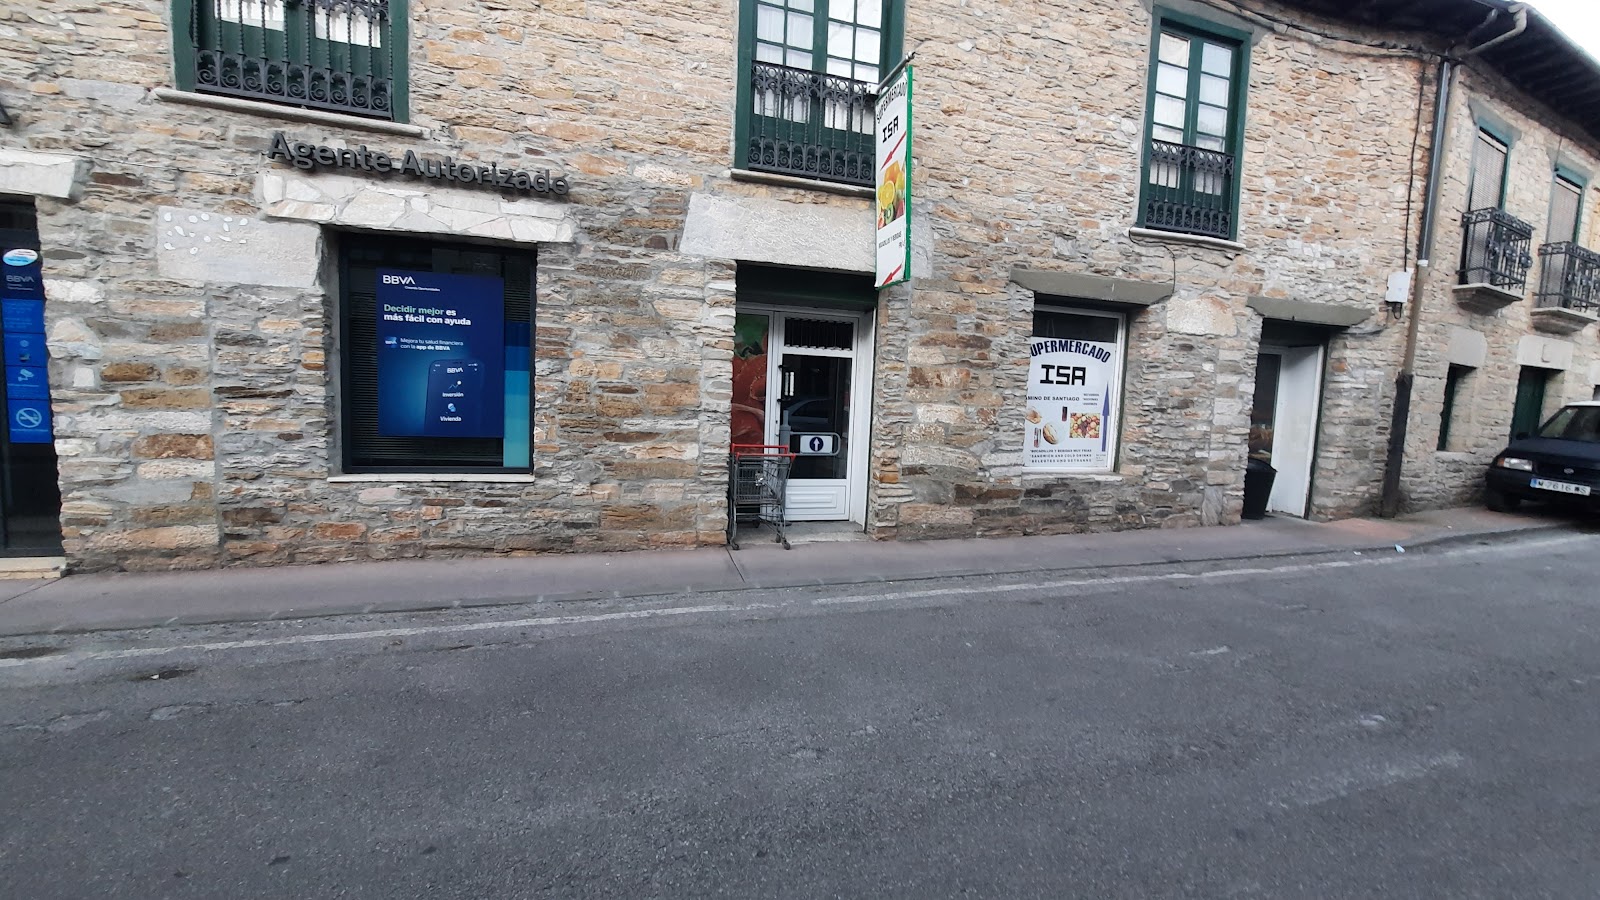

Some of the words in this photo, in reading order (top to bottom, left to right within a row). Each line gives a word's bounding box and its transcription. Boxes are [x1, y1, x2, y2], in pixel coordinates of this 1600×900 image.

[882, 115, 899, 143] ISA
[267, 133, 392, 172] Agente
[400, 149, 570, 195] Autorizado
[383, 275, 415, 284] BBVA
[384, 304, 416, 313] Decidir
[418, 308, 444, 316] mejor
[384, 313, 403, 321] más
[405, 313, 424, 322] fácil
[444, 318, 471, 326] ayuda
[1030, 340, 1111, 363] UPERMERCADO
[1040, 364, 1086, 386] ISA
